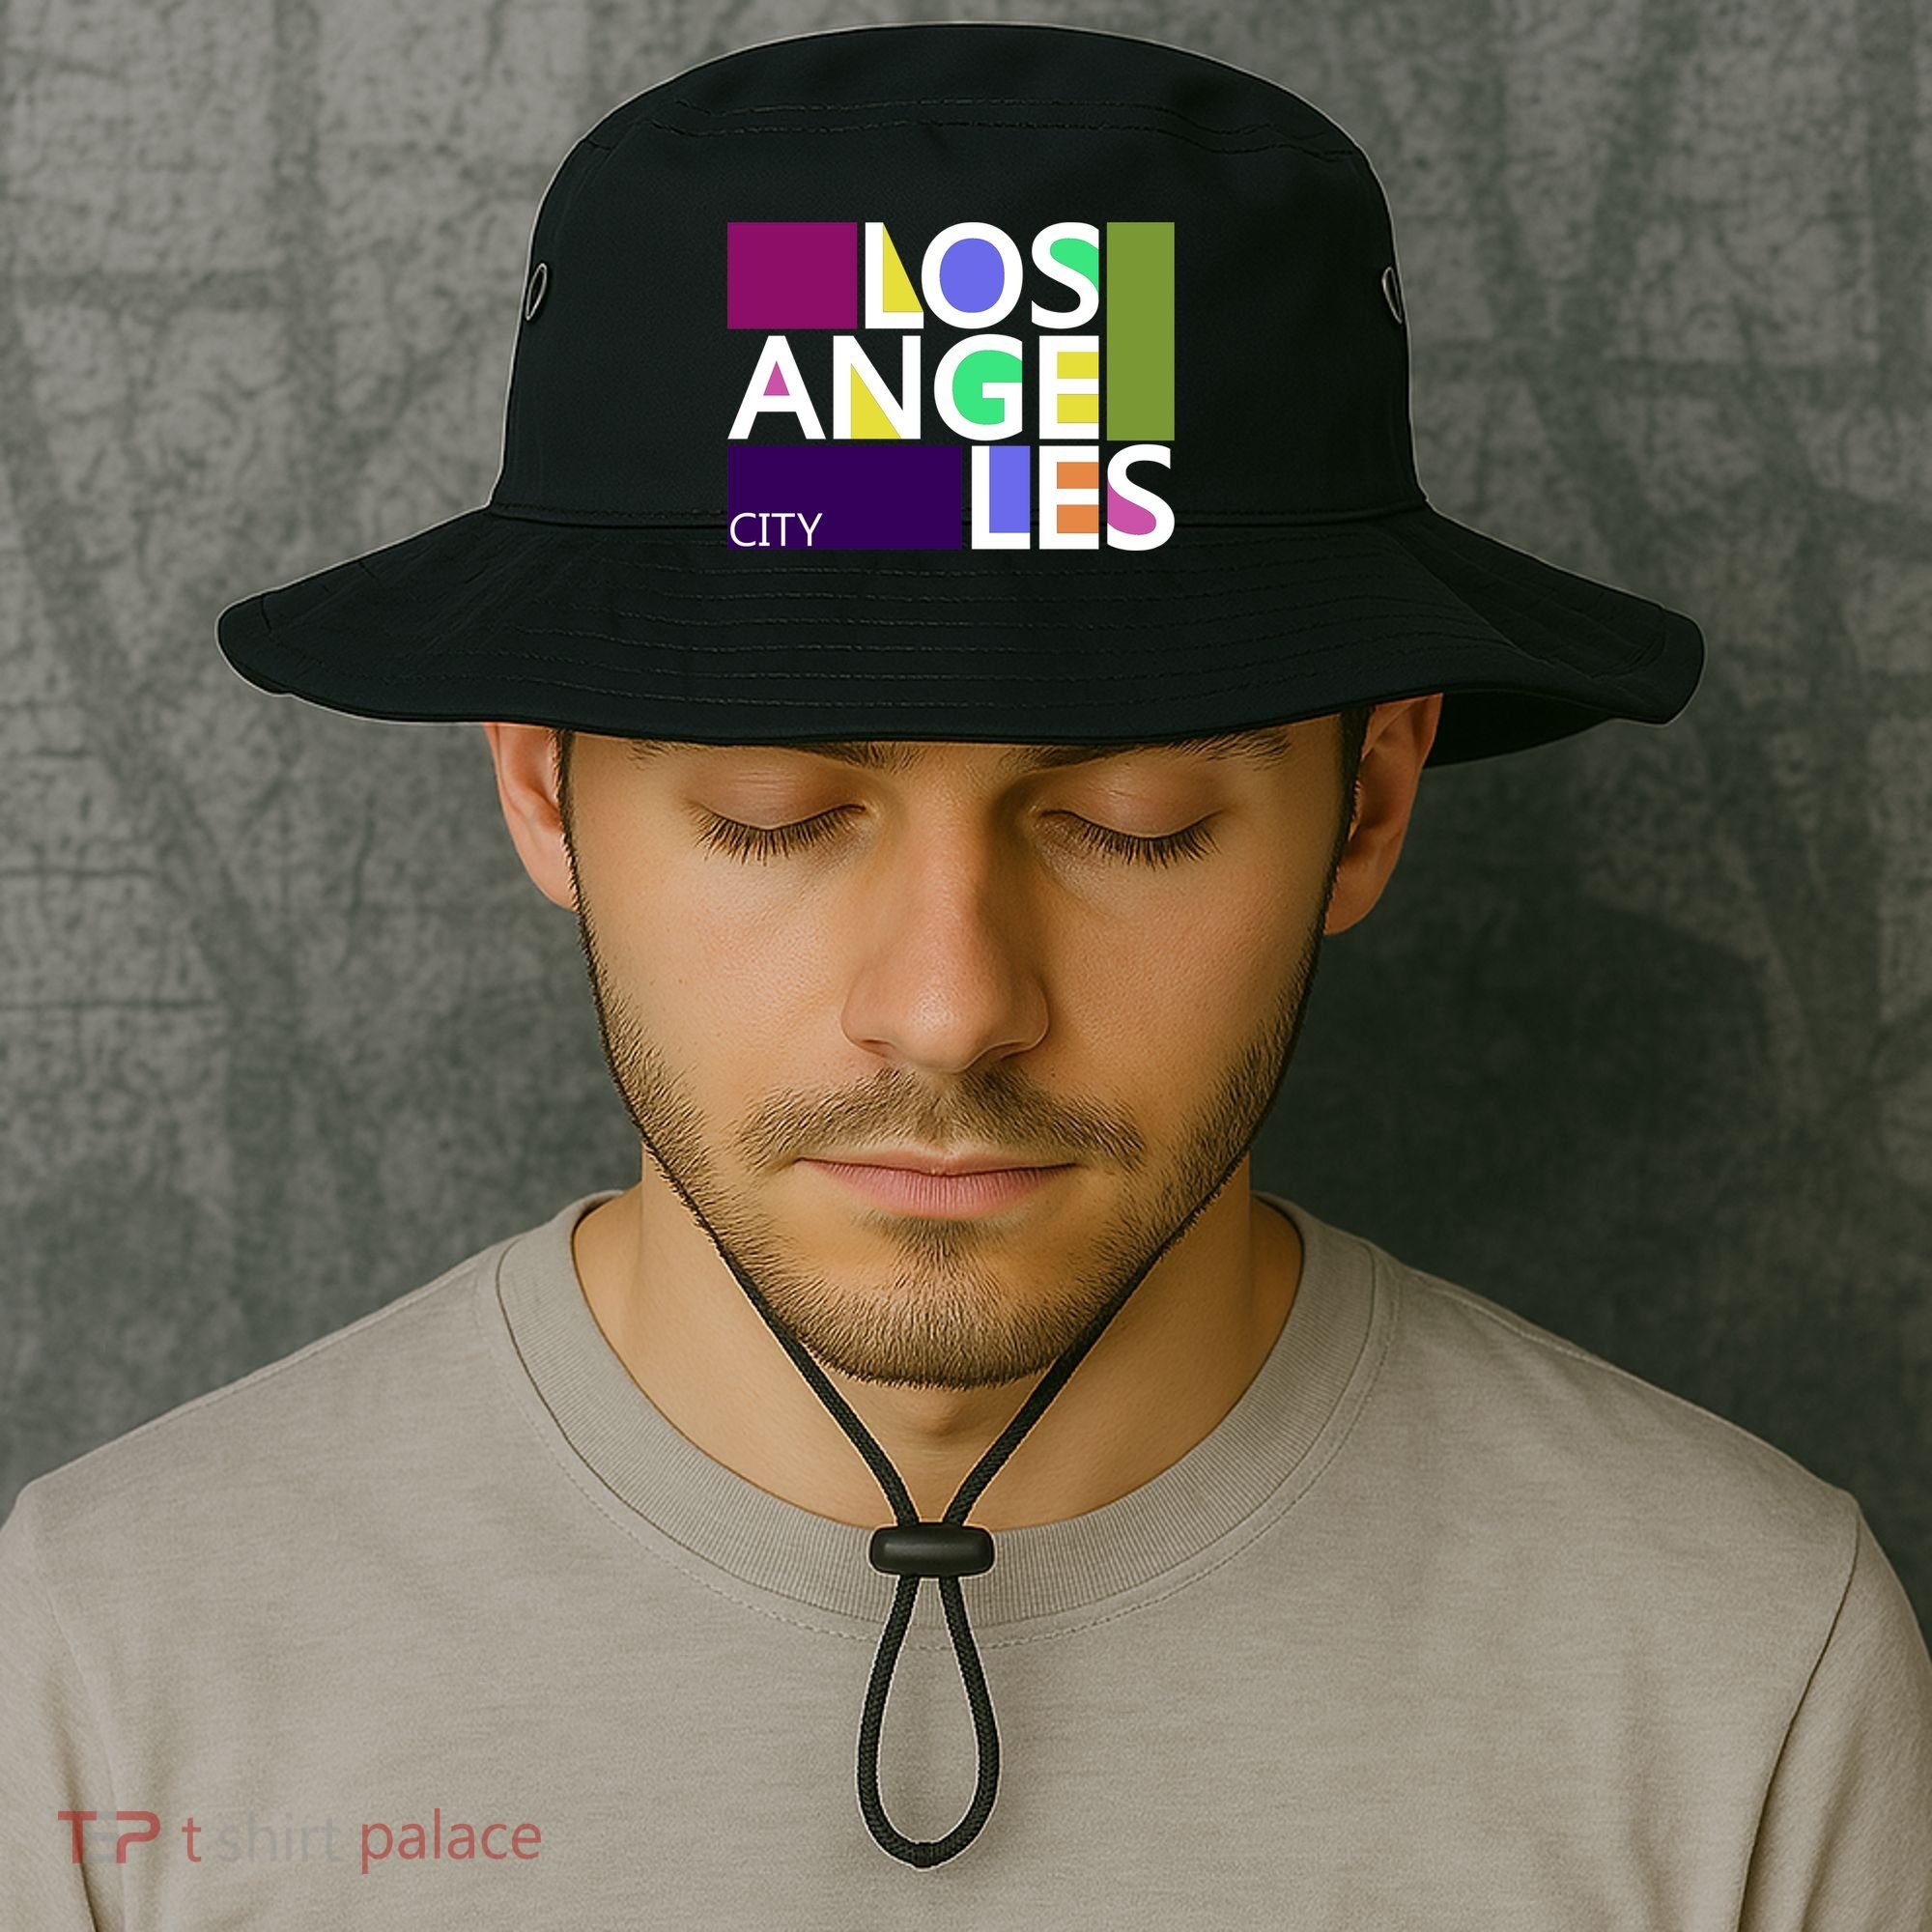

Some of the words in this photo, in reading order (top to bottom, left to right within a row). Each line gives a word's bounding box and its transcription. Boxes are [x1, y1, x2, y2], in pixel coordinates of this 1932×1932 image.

[865, 221, 1099, 329] LOS
[727, 333, 1099, 440] ANGE
[729, 512, 823, 547] CITY
[971, 443, 1176, 552] LES
